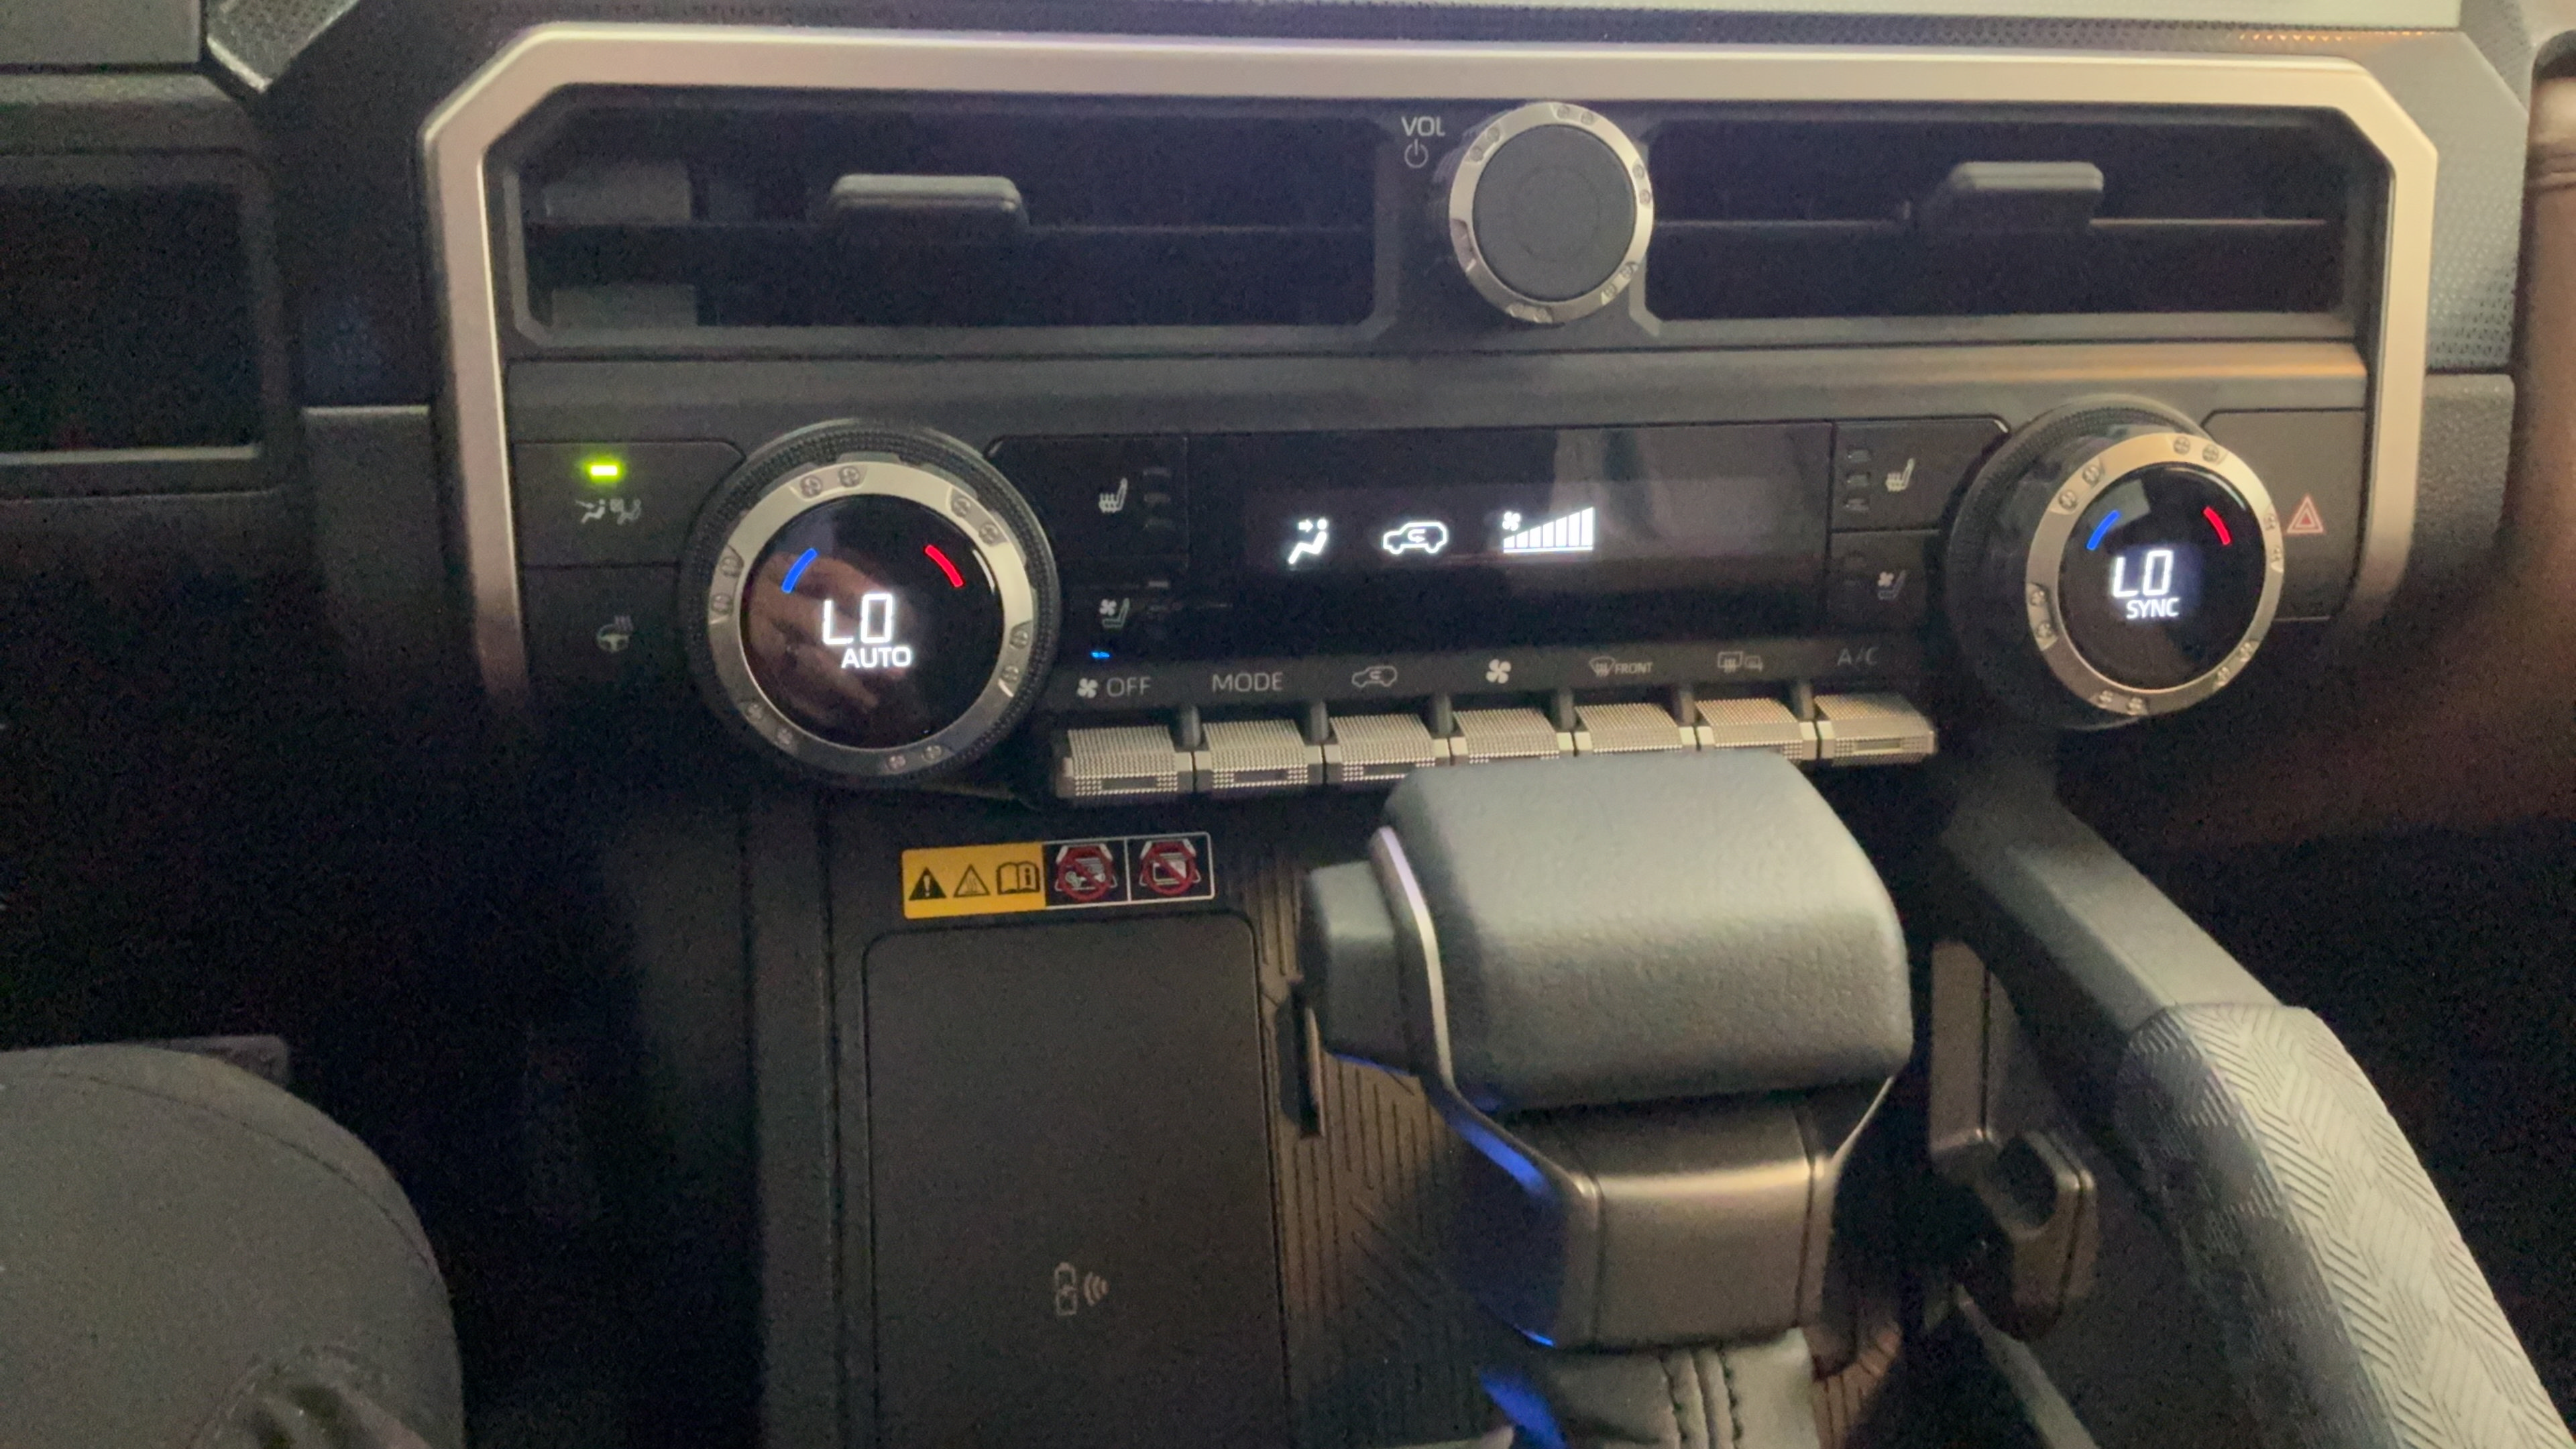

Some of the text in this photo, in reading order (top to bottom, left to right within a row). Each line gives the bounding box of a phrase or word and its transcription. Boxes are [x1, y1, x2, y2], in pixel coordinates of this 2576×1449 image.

[1401, 116, 1445, 137] VOL
[2126, 598, 2180, 619] SYNC
[842, 647, 912, 669] AUTO
[1836, 645, 1880, 667] A/C
[1614, 661, 1654, 676] FRONT
[1106, 676, 1152, 697] OFF
[1212, 671, 1284, 693] MODE
